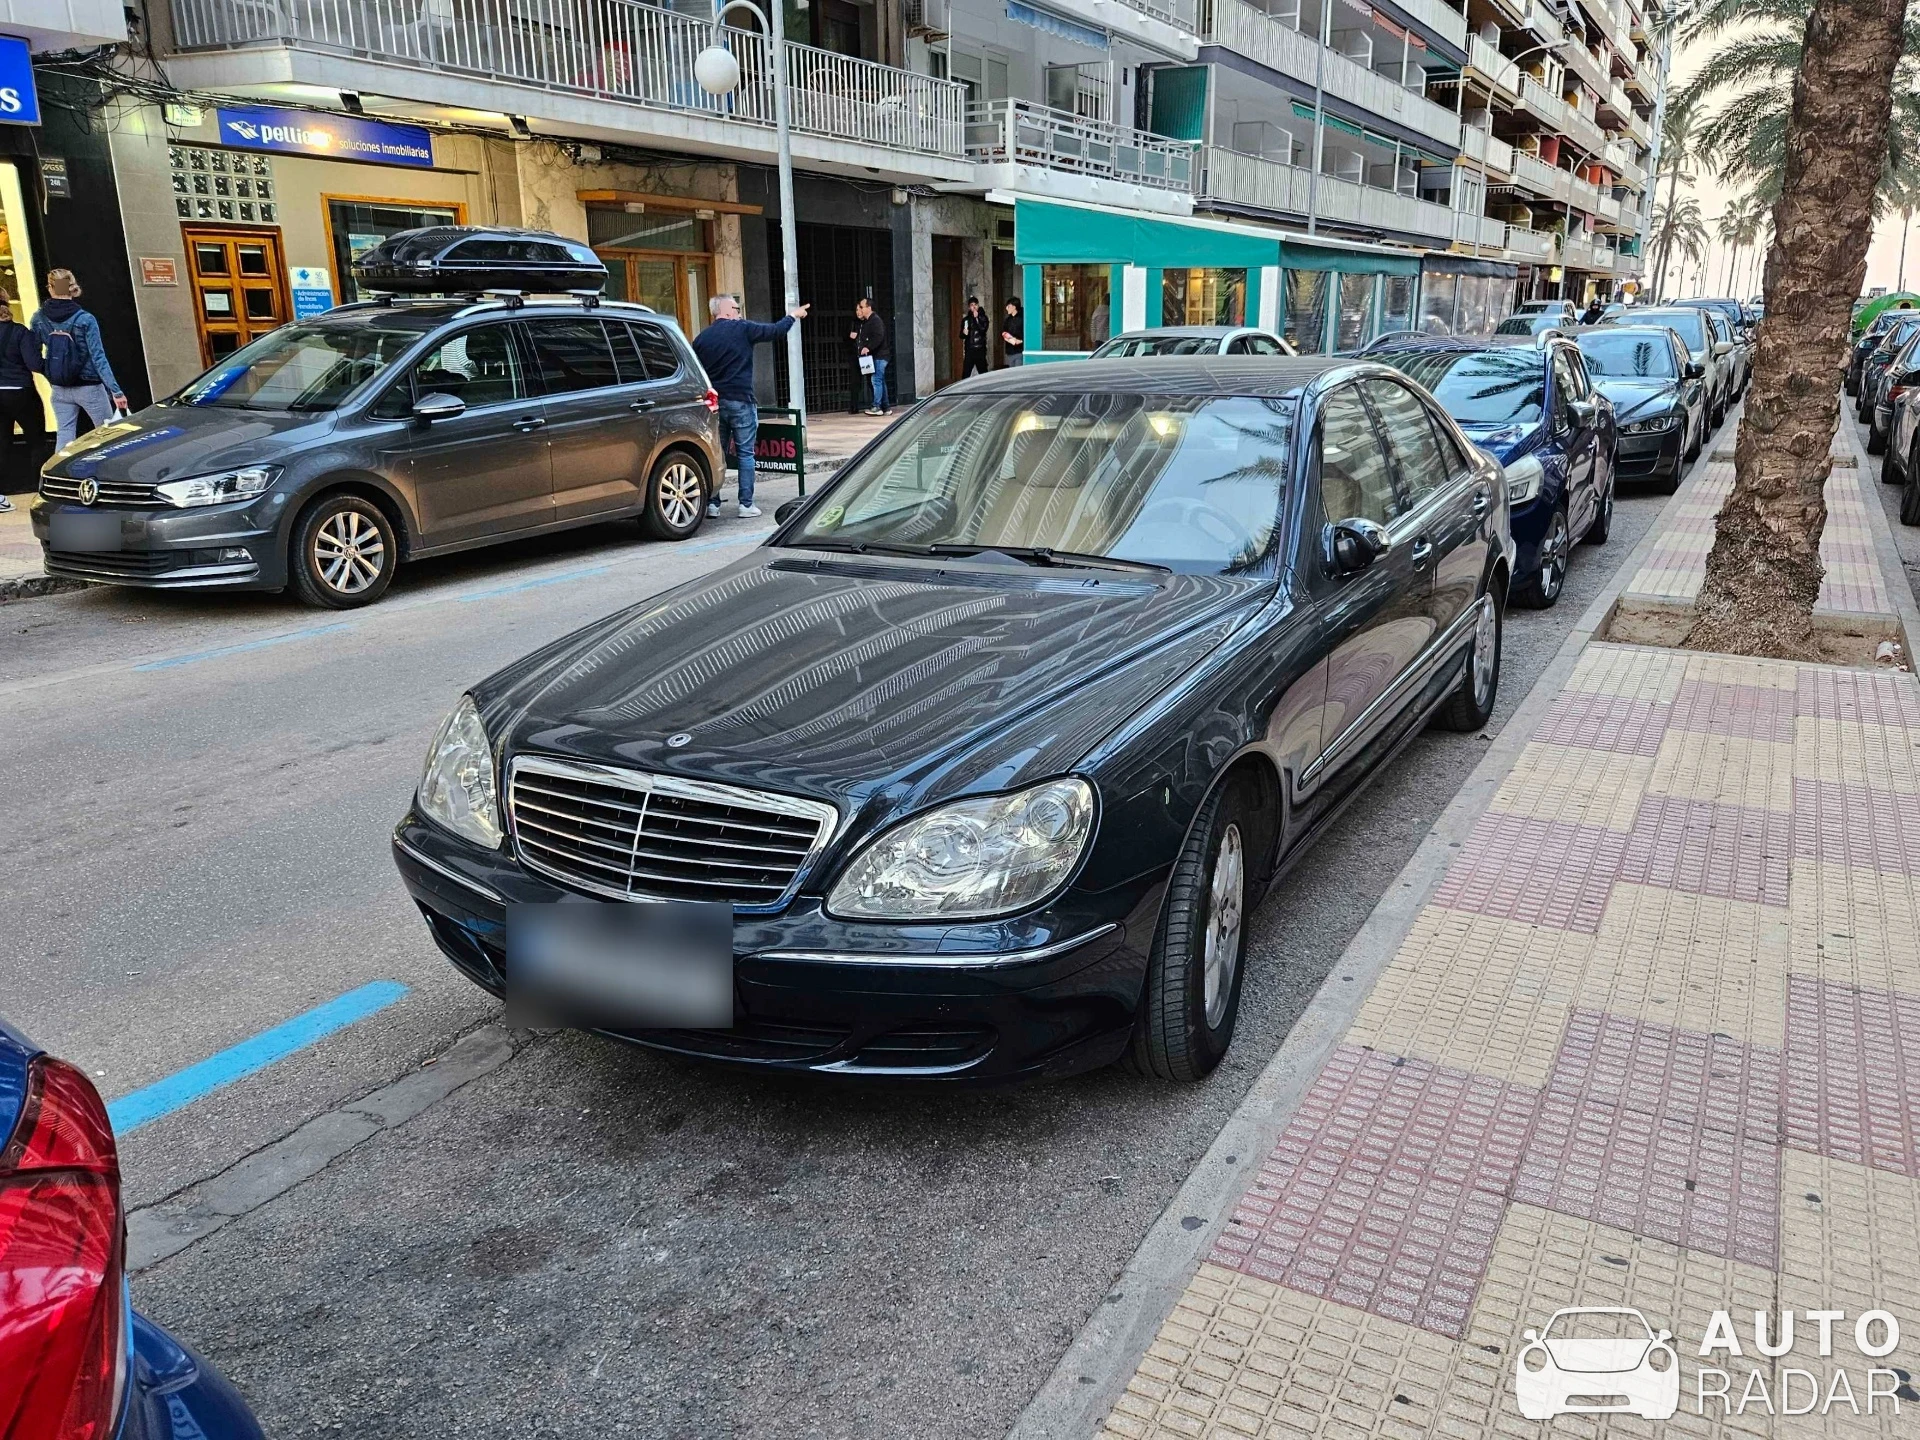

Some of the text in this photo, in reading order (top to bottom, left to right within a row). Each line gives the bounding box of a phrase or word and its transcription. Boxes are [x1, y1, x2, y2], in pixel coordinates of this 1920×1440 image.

[339, 139, 381, 153] soluciones
[382, 144, 429, 158] inmobiliarias
[756, 461, 797, 471] STAURANTE
